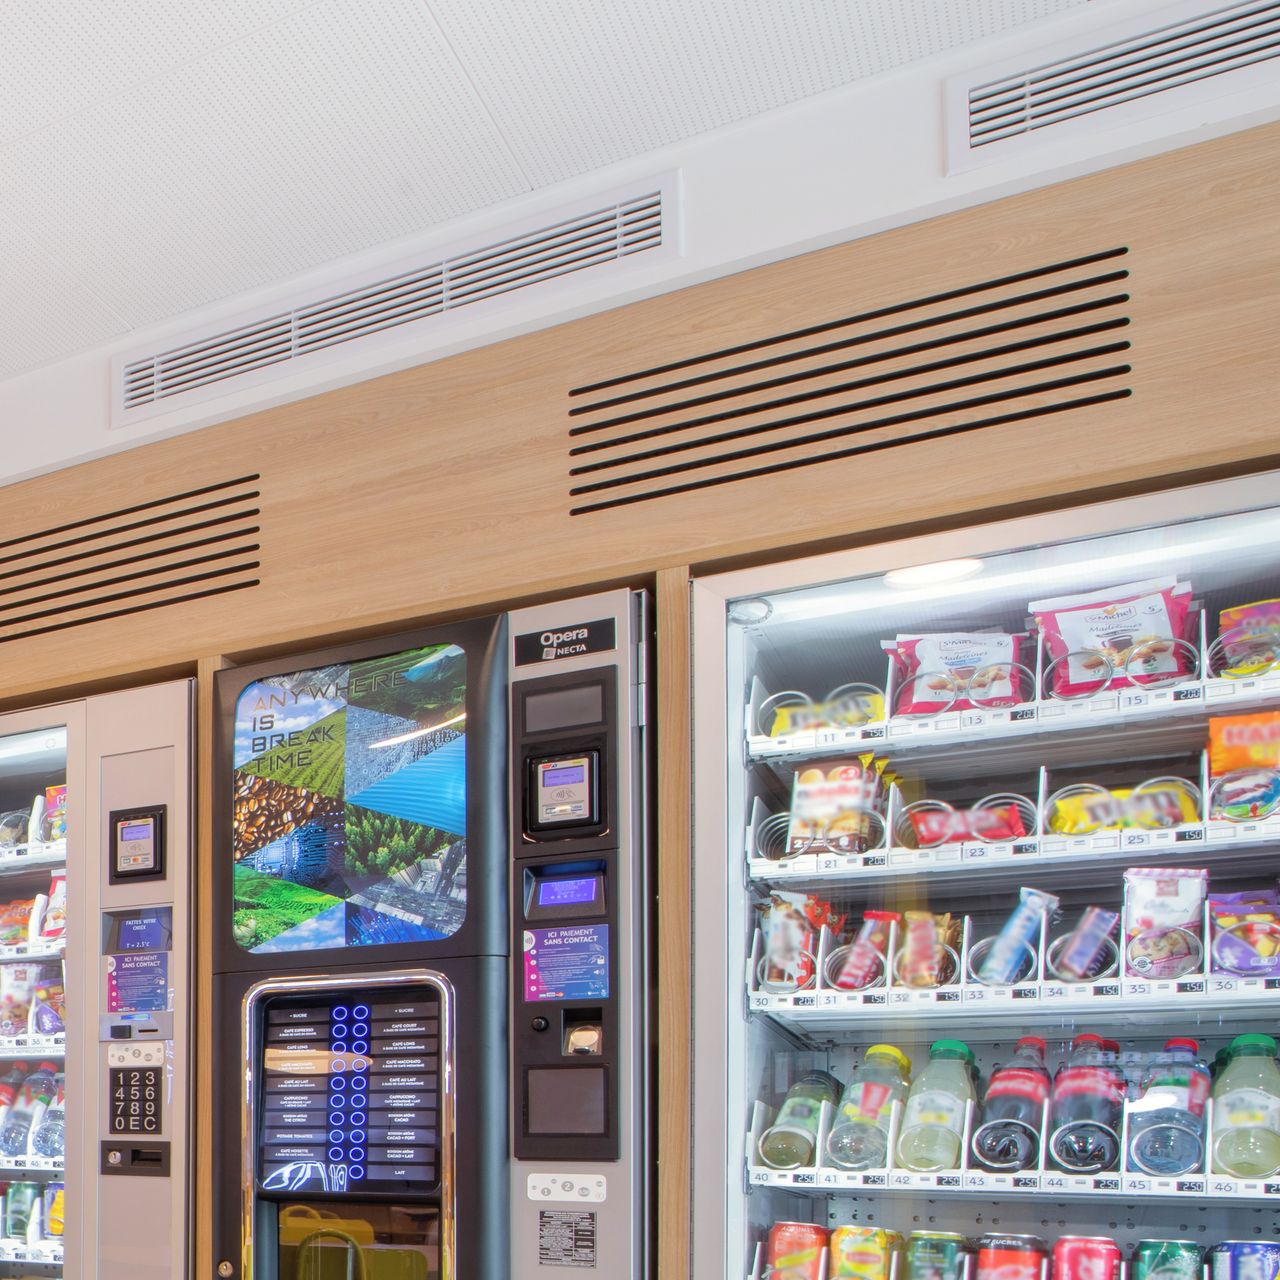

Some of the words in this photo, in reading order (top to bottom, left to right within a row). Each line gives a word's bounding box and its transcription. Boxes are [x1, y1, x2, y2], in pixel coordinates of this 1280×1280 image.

[540, 628, 588, 647] Opera
[557, 644, 587, 656] NECTA
[254, 669, 407, 710] ANYWHERE
[1127, 696, 1142, 705] 15
[252, 714, 274, 732] IS
[968, 716, 982, 724] 13
[252, 723, 335, 753] BREAK
[824, 733, 835, 742] 11
[252, 749, 312, 773] TIME
[1128, 835, 1144, 844] 25
[969, 848, 985, 857] 23
[824, 859, 837, 868] 21
[560, 929, 594, 937] PAIEMENT
[544, 938, 562, 946] SANS
[564, 936, 598, 944] CONTACT
[1129, 984, 1145, 994] 35
[1215, 981, 1233, 990] 36
[969, 990, 984, 999] 33
[1047, 988, 1063, 997] 34
[755, 998, 768, 1006] 30
[824, 996, 836, 1004] 31
[895, 994, 909, 1002] 32
[117, 1072, 123, 1085] 1
[131, 1072, 140, 1085] 2
[145, 1071, 155, 1085] 3
[115, 1087, 125, 1100] 4
[130, 1087, 140, 1100] 5
[145, 1087, 155, 1100] 6
[115, 1102, 125, 1115] 7
[130, 1102, 140, 1115] 8
[145, 1102, 155, 1115] 9
[115, 1117, 125, 1130] 0
[130, 1117, 140, 1130] E
[144, 1116, 156, 1130] C
[754, 1173, 768, 1181] 40
[824, 1175, 836, 1184] 41
[895, 1176, 910, 1184] 42
[969, 1176, 985, 1186] 43
[1047, 1178, 1063, 1187] 44
[1129, 1180, 1146, 1190] 45
[1214, 1182, 1232, 1192] 46
[993, 1239, 1023, 1247] SUCRES
